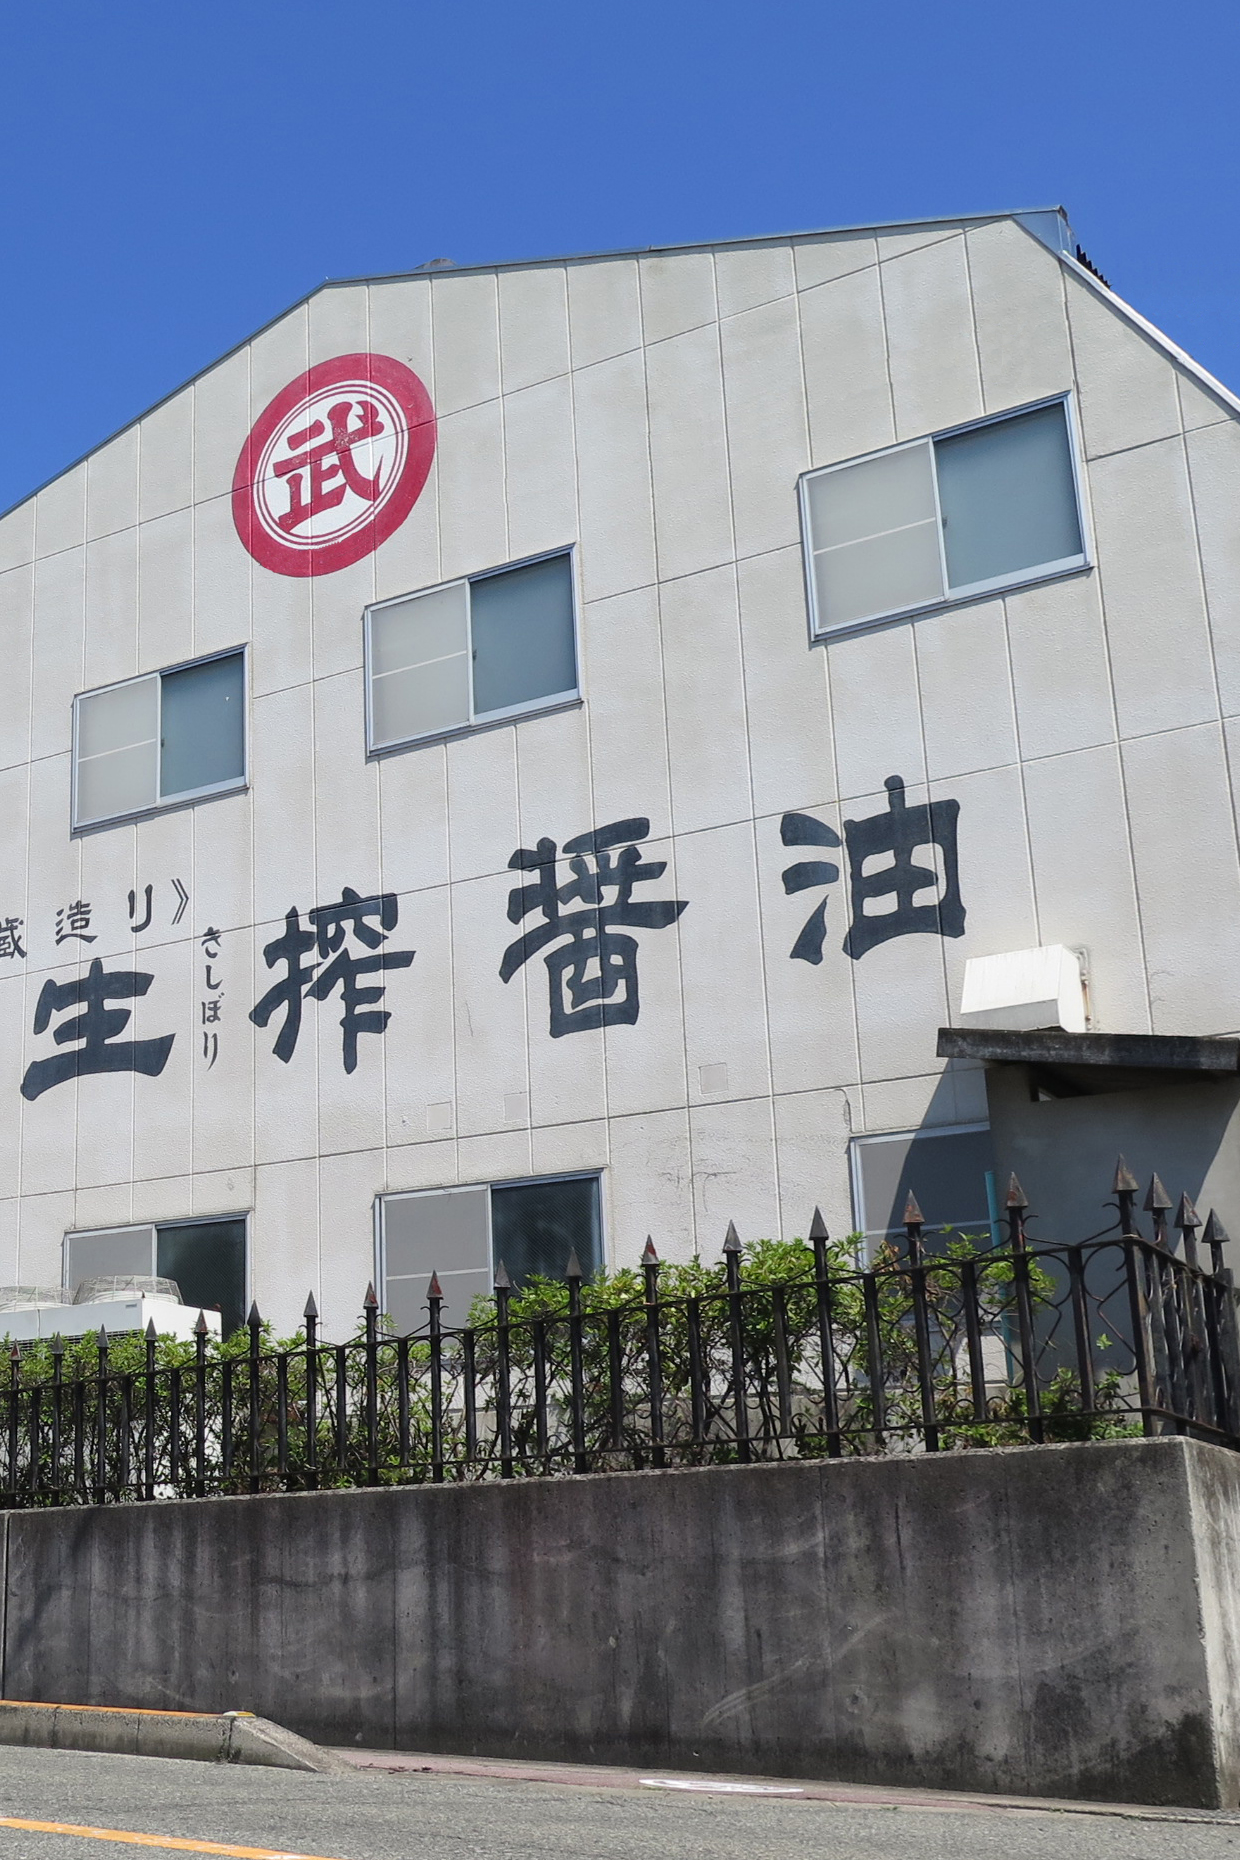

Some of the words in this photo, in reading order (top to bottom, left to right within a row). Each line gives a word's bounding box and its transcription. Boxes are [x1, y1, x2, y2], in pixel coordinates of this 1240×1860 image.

[273, 401, 385, 532] 武
[201, 926, 225, 1072] きしぼり
